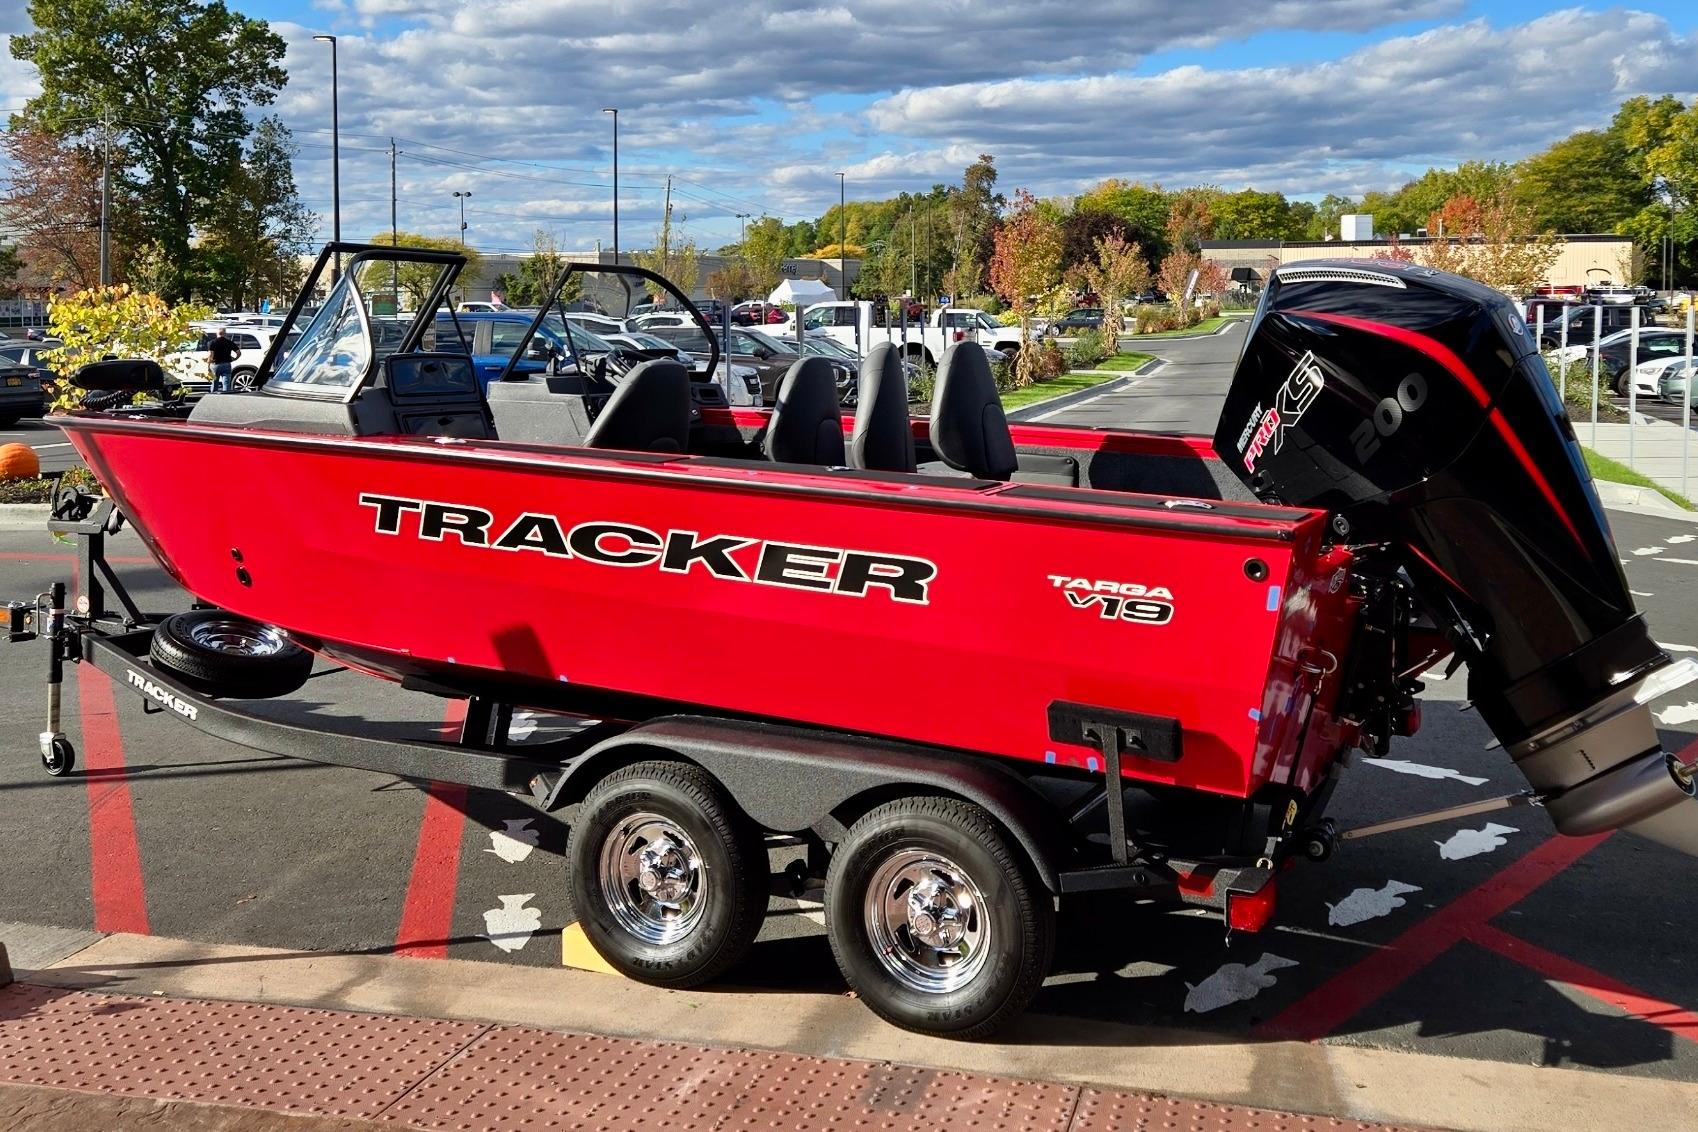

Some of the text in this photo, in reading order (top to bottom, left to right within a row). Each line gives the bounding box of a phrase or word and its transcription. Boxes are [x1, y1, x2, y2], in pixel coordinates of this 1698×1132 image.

[1237, 401, 1262, 453] MERCURY
[1244, 350, 1324, 474] PRO XS
[1350, 372, 1428, 465] 200
[359, 492, 937, 605] TRACKER
[1047, 574, 1174, 600] TARGA
[1063, 590, 1175, 625] V19
[126, 669, 198, 720] TRACKER
